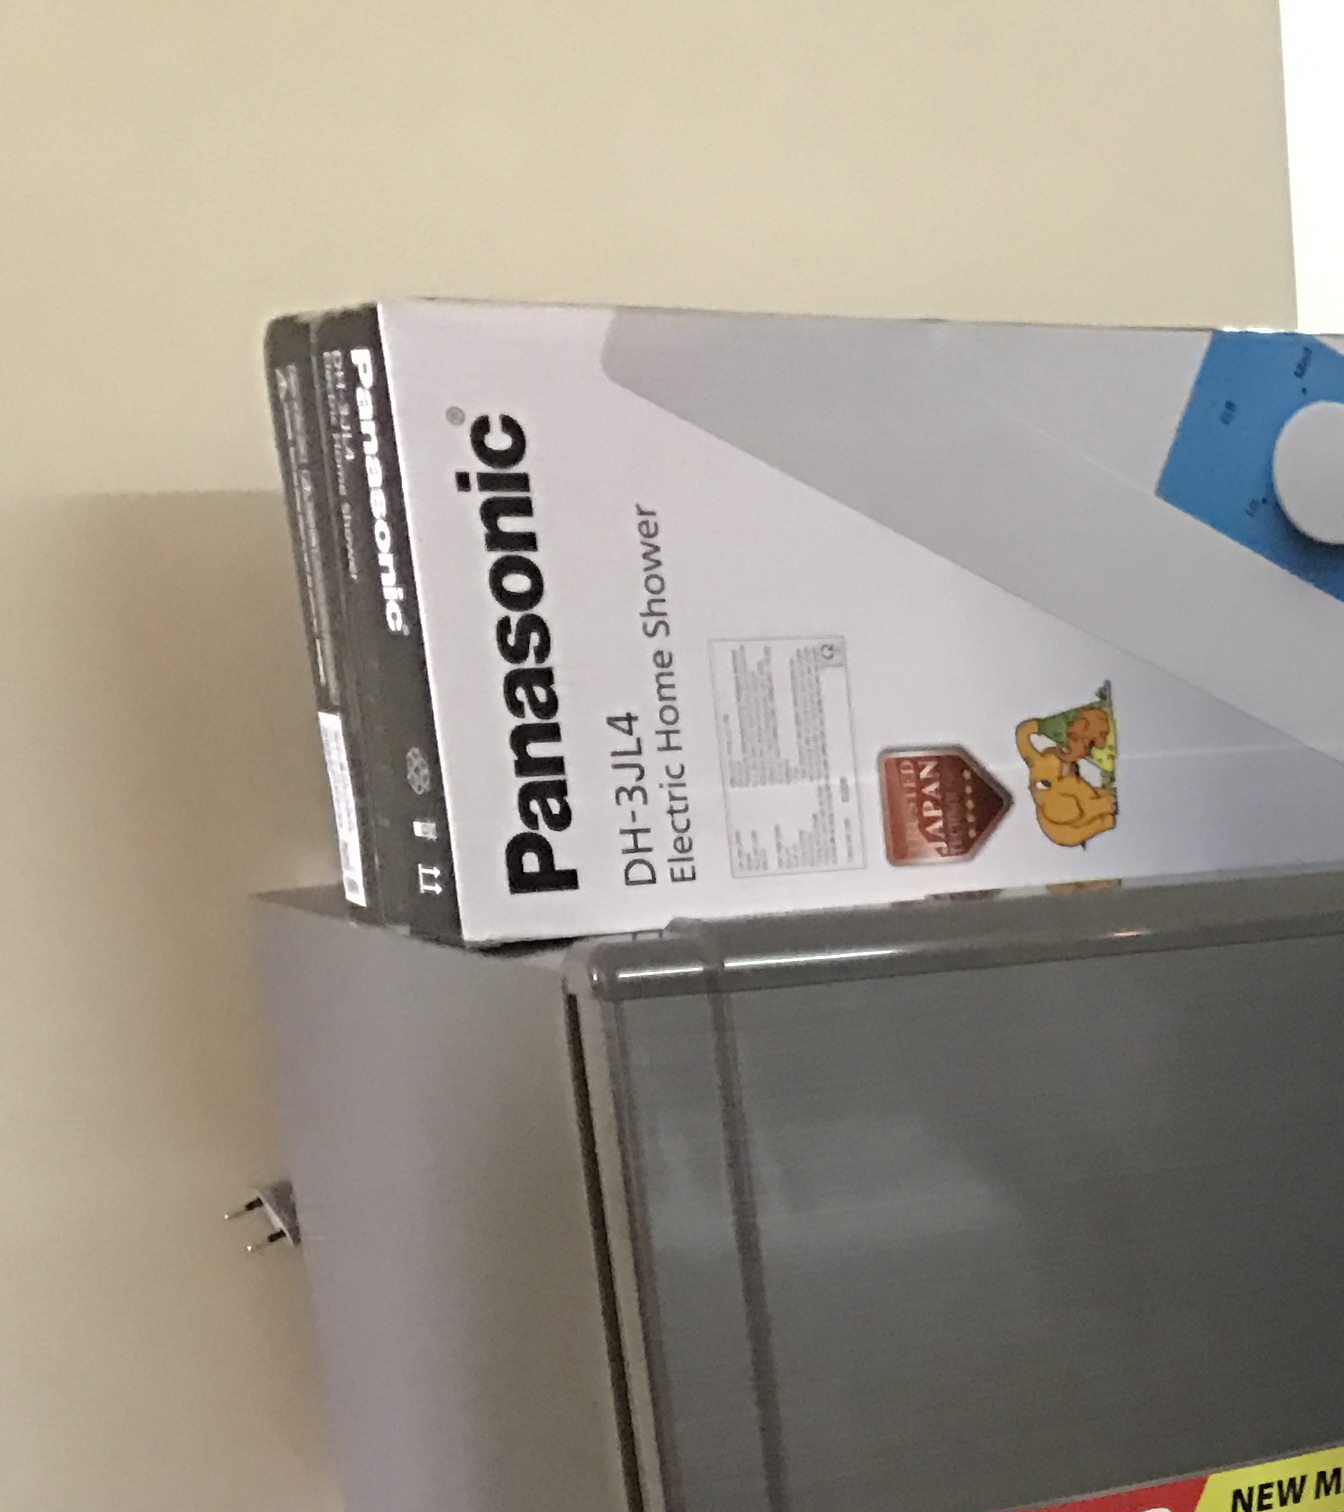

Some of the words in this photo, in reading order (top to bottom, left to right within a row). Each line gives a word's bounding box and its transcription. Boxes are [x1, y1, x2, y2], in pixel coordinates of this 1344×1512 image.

[350, 348, 404, 632] Panasonic
[635, 503, 671, 639] Shower
[455, 413, 580, 895] Panasonic
[651, 649, 684, 753] Home
[606, 711, 657, 887] DH-3JL4
[657, 762, 698, 884] Electric
[917, 760, 948, 855] JAPAN
